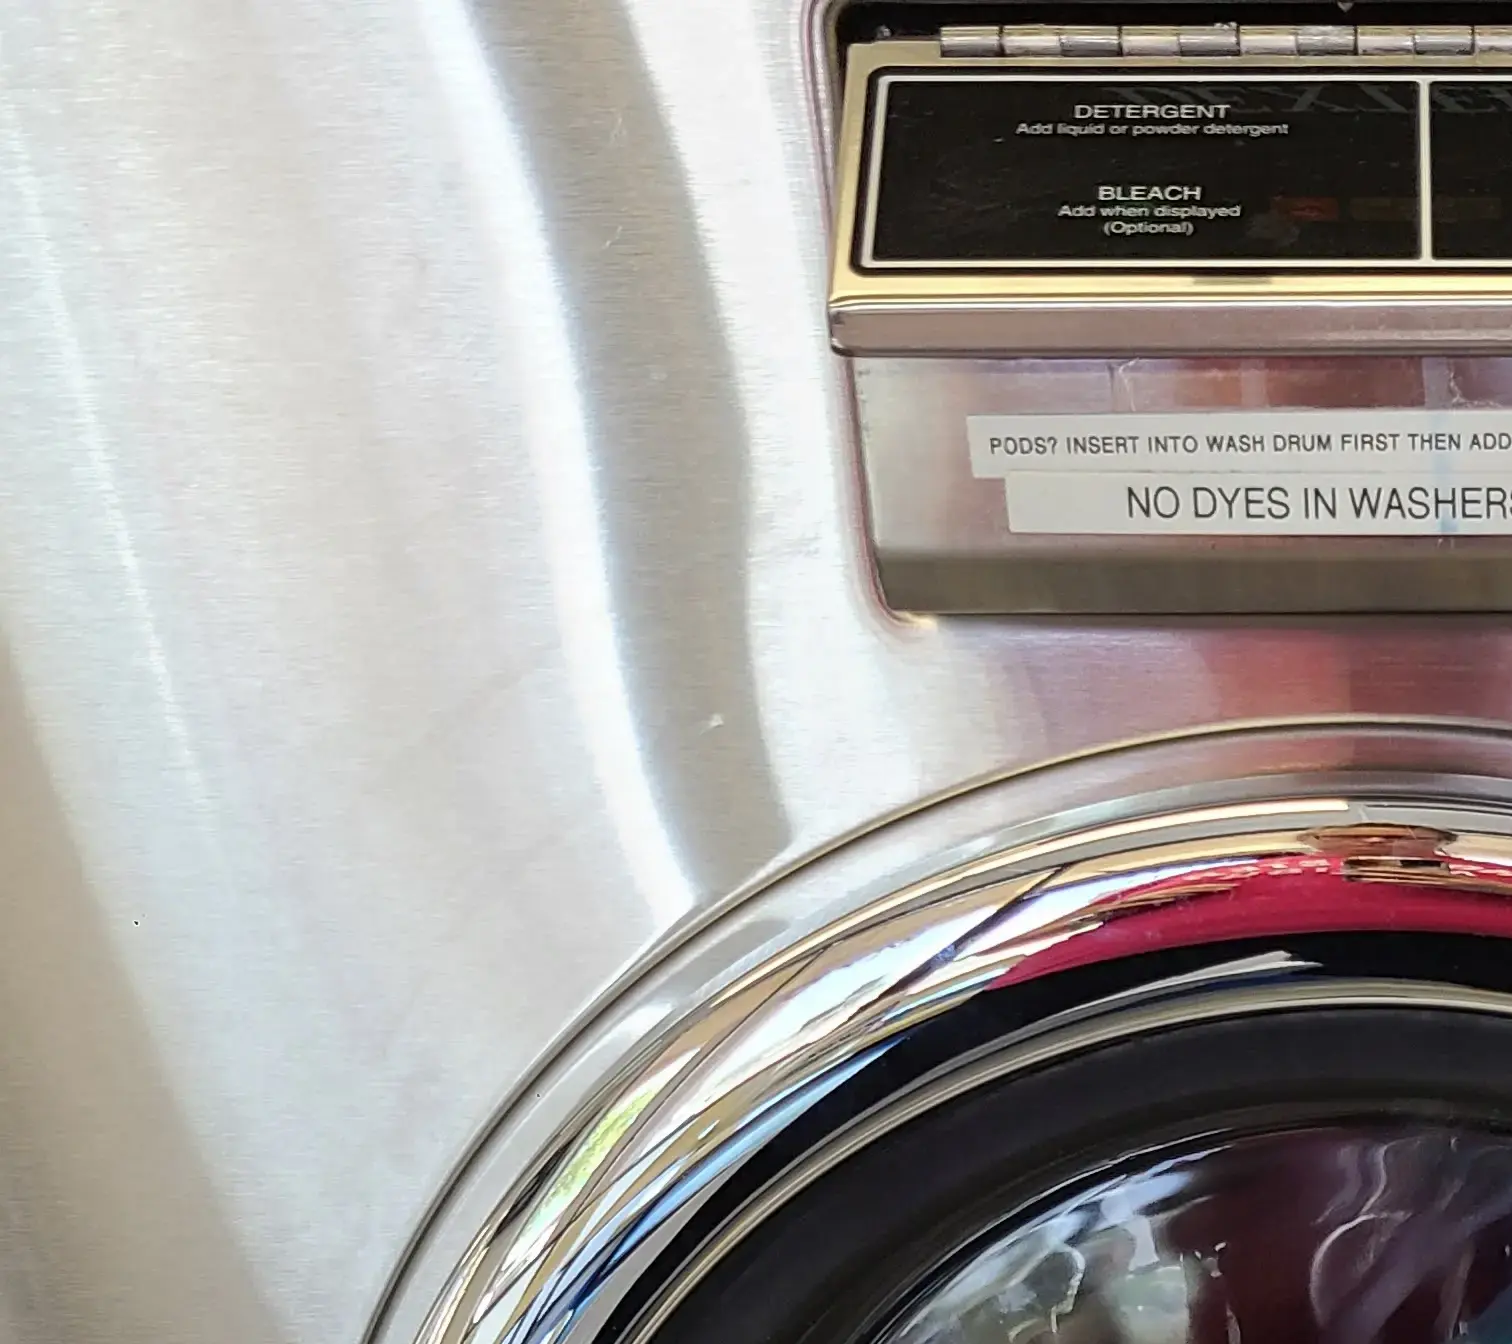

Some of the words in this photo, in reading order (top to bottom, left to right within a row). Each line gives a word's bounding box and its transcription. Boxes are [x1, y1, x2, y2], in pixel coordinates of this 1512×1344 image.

[1074, 104, 1231, 119] DETERGENT
[1015, 123, 1053, 135] Add
[1057, 122, 1105, 137] liquid
[1109, 124, 1128, 135] or
[1132, 122, 1200, 137] powder
[1203, 122, 1289, 137] detergent
[1098, 186, 1202, 201] BLEACH
[1057, 205, 1096, 217] Add
[1100, 205, 1150, 217] when
[1153, 204, 1241, 219] displayed
[1103, 221, 1194, 236] (Optional)
[988, 435, 1059, 455] PODS?
[1066, 435, 1140, 455] INSERT
[1147, 435, 1199, 454] INTO
[1206, 434, 1265, 453] WASH
[1272, 434, 1332, 453] DRUM
[1340, 433, 1400, 451] FIRST
[1407, 433, 1462, 451] THEN
[1469, 433, 1512, 450] ADD
[1126, 486, 1181, 519] NO
[1192, 486, 1290, 520] DYES
[1303, 486, 1337, 520] IN
